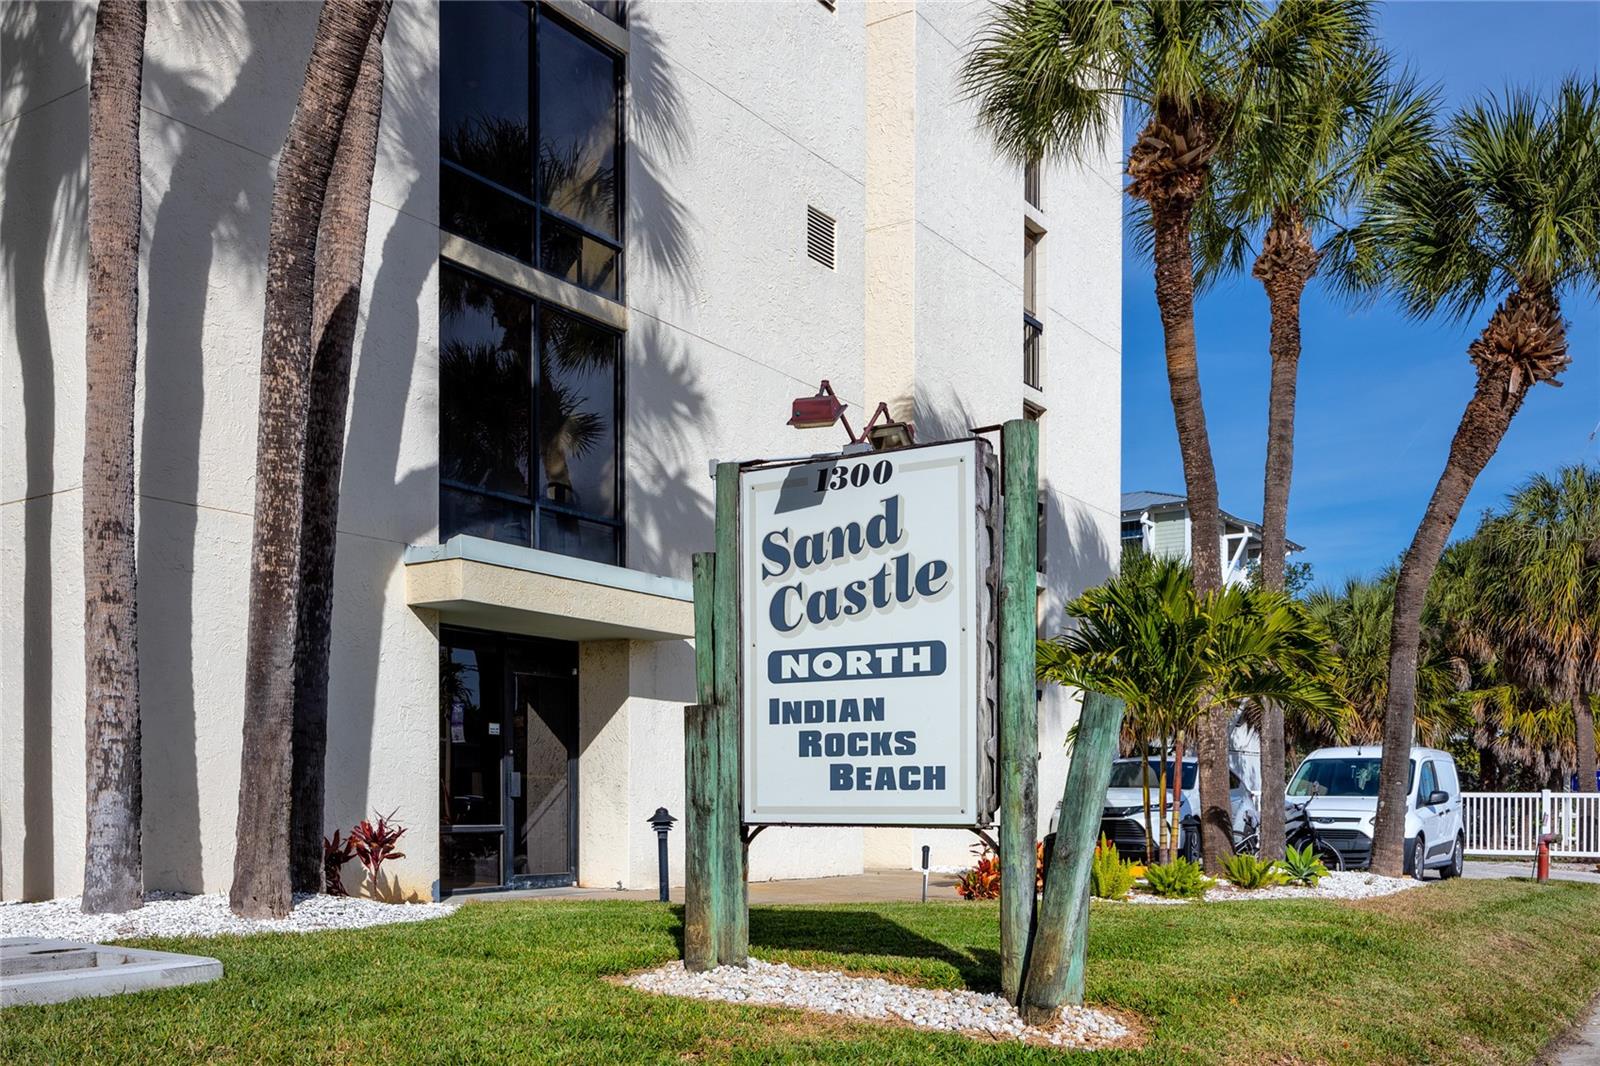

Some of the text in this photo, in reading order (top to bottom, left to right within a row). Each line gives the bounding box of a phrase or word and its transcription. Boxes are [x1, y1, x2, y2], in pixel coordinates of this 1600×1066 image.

[813, 459, 893, 493] 1300
[761, 494, 903, 581] Sand
[768, 552, 949, 633] Castle
[780, 645, 932, 679] NORTH
[768, 696, 885, 725] INDIAN
[798, 730, 917, 758] ROCKS
[829, 763, 946, 792] BEACH
